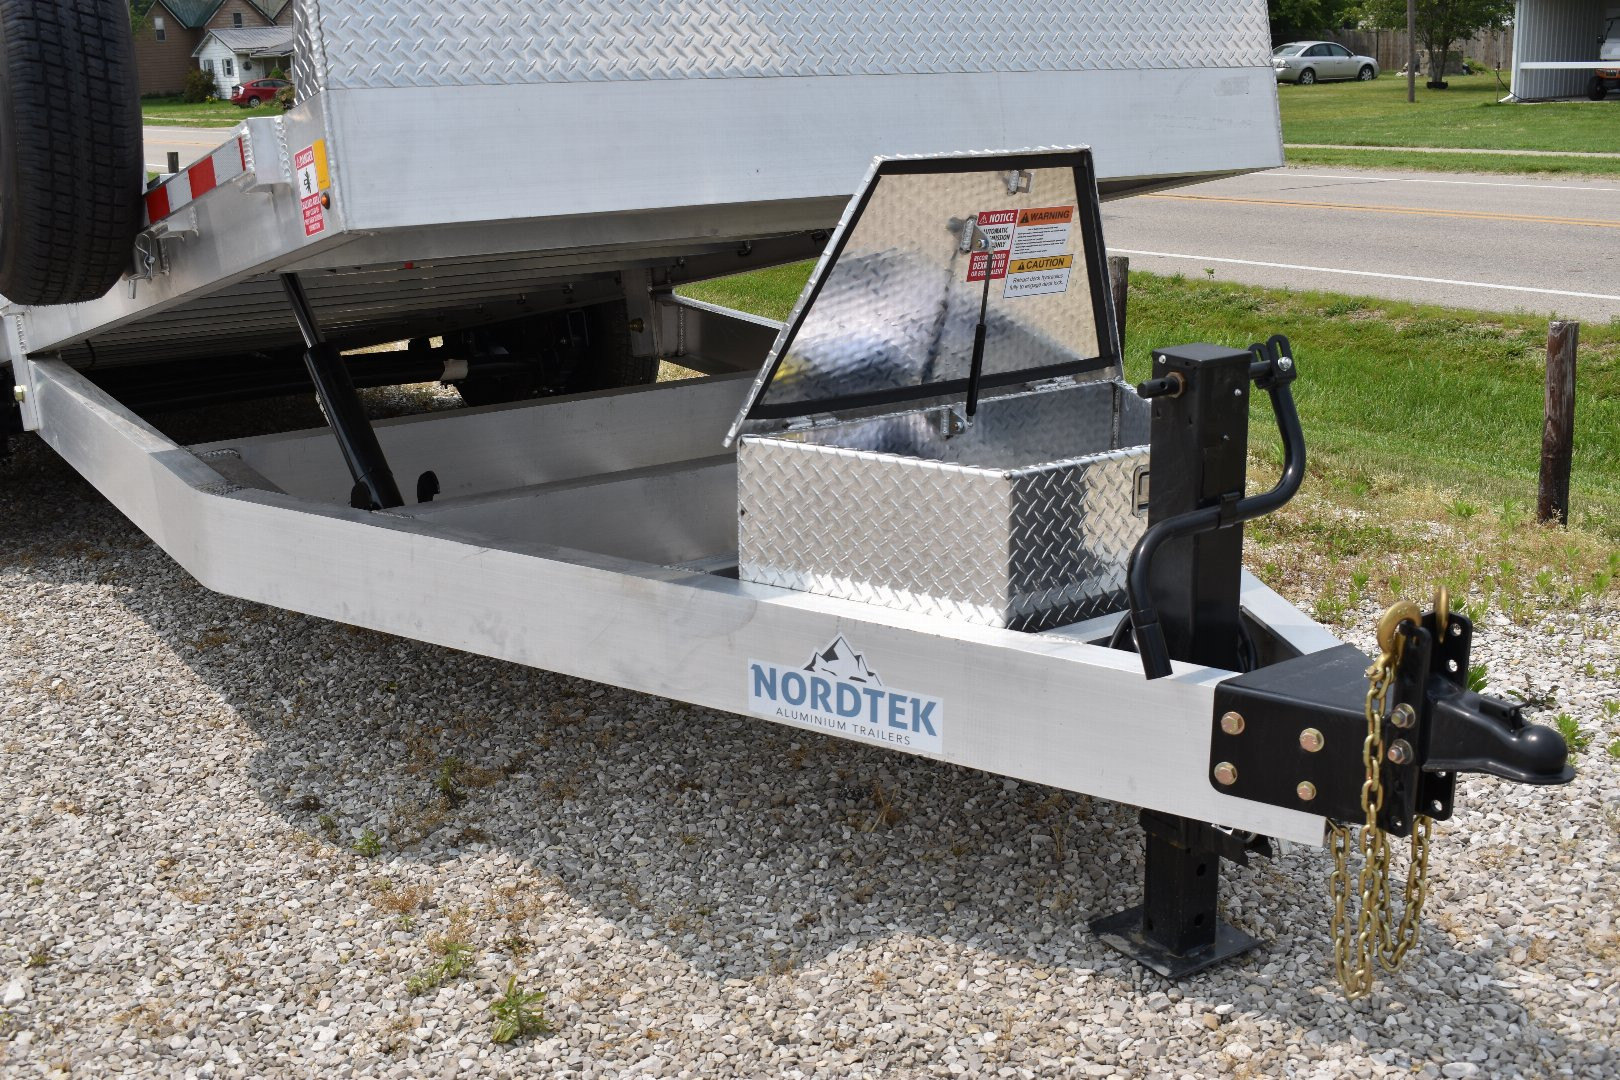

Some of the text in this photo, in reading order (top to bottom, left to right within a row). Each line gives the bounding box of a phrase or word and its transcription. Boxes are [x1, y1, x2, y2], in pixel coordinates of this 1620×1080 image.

[989, 212, 1015, 224] NOTICE
[1030, 210, 1070, 221] WARNING
[973, 253, 1006, 262] RECOMENDED
[972, 260, 997, 270] DEXRN
[1026, 258, 1065, 269] CAUTION
[751, 663, 937, 736] NORDTEK
[776, 707, 911, 746] ALUMINIUM TRAILERS
